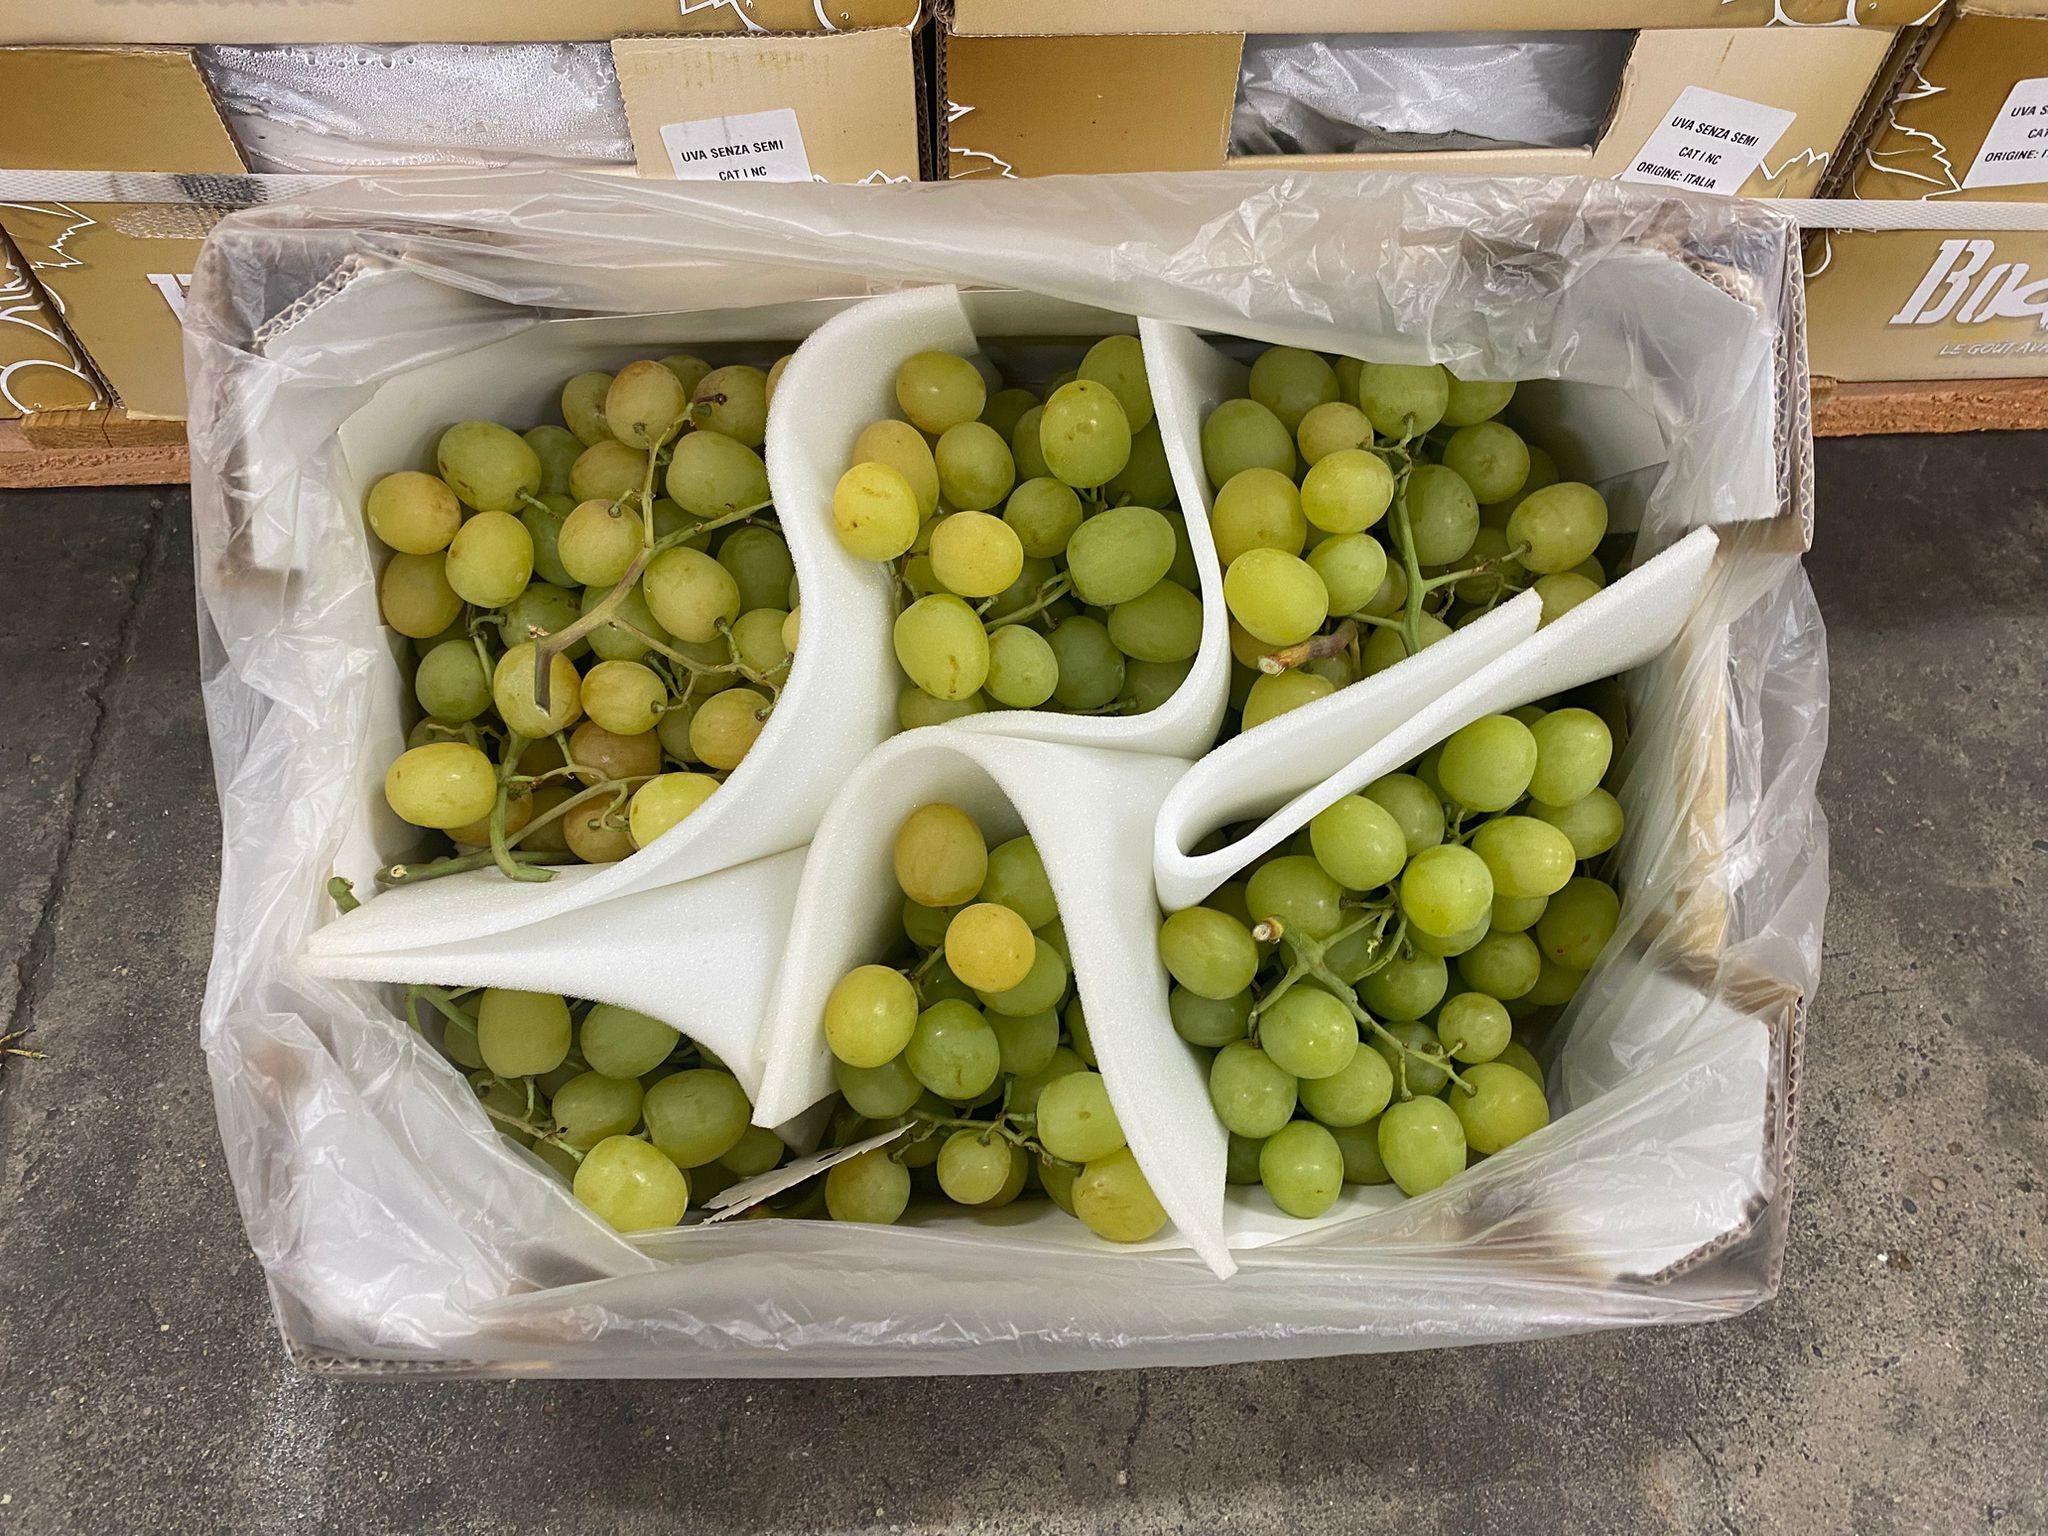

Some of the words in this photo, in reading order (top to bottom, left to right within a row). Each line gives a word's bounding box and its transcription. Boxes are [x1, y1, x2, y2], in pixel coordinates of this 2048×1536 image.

[2010, 105, 2036, 117] UVA
[2040, 105, 2048, 116] S
[1671, 116, 1694, 131] UVA
[1695, 123, 1730, 140] SENZA
[1730, 132, 1760, 147] SEMI
[681, 150, 708, 162] UVA
[711, 144, 750, 158] SENZA
[752, 139, 784, 153] SEMI
[1678, 146, 1701, 161] CAT
[1705, 153, 1722, 165] NC
[1984, 150, 2040, 163] ORIGINE:
[718, 168, 740, 181] CAT
[752, 166, 767, 177] NC
[1636, 161, 1683, 182] ORIGINE:
[1682, 172, 1716, 189] ITALIA
[1939, 344, 1966, 355] LE
